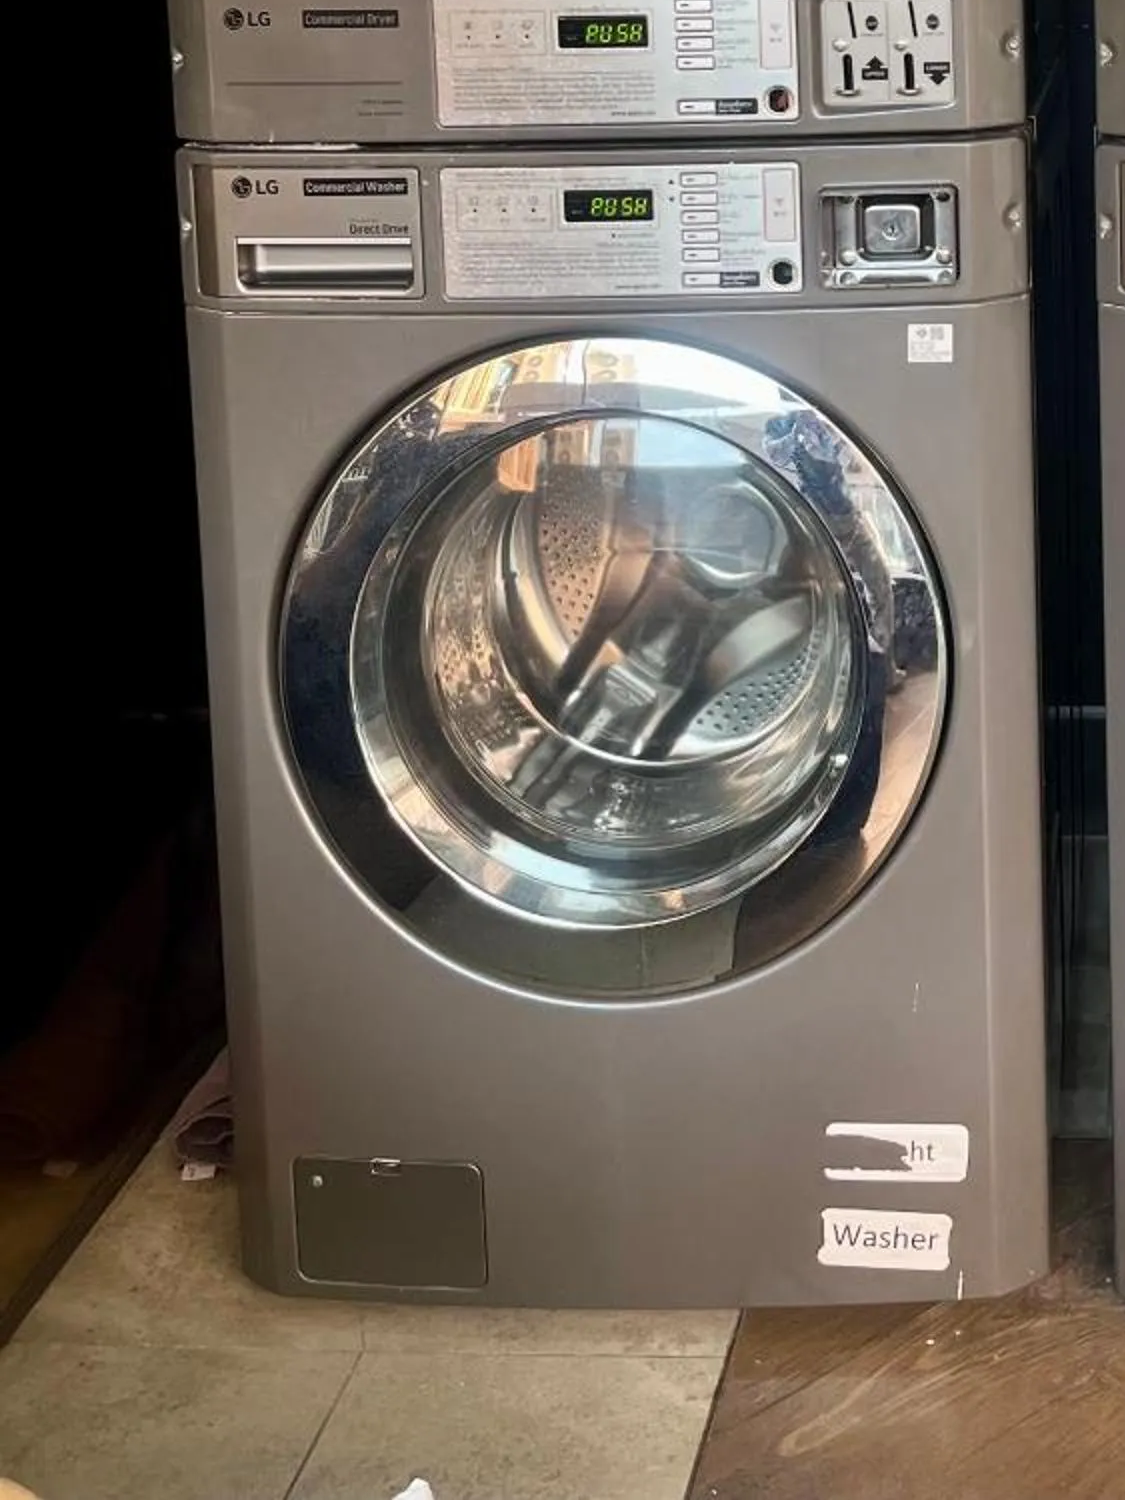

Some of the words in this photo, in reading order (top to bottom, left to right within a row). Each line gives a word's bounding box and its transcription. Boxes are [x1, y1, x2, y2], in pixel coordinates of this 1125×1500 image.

[247, 11, 272, 27] LG
[305, 12, 365, 26] Commercial
[367, 12, 397, 27] Dryer
[255, 179, 280, 195] LG
[304, 180, 364, 194] Commercial
[365, 180, 407, 193] Washer
[350, 223, 380, 235] Direct
[833, 1224, 941, 1251] Washer
